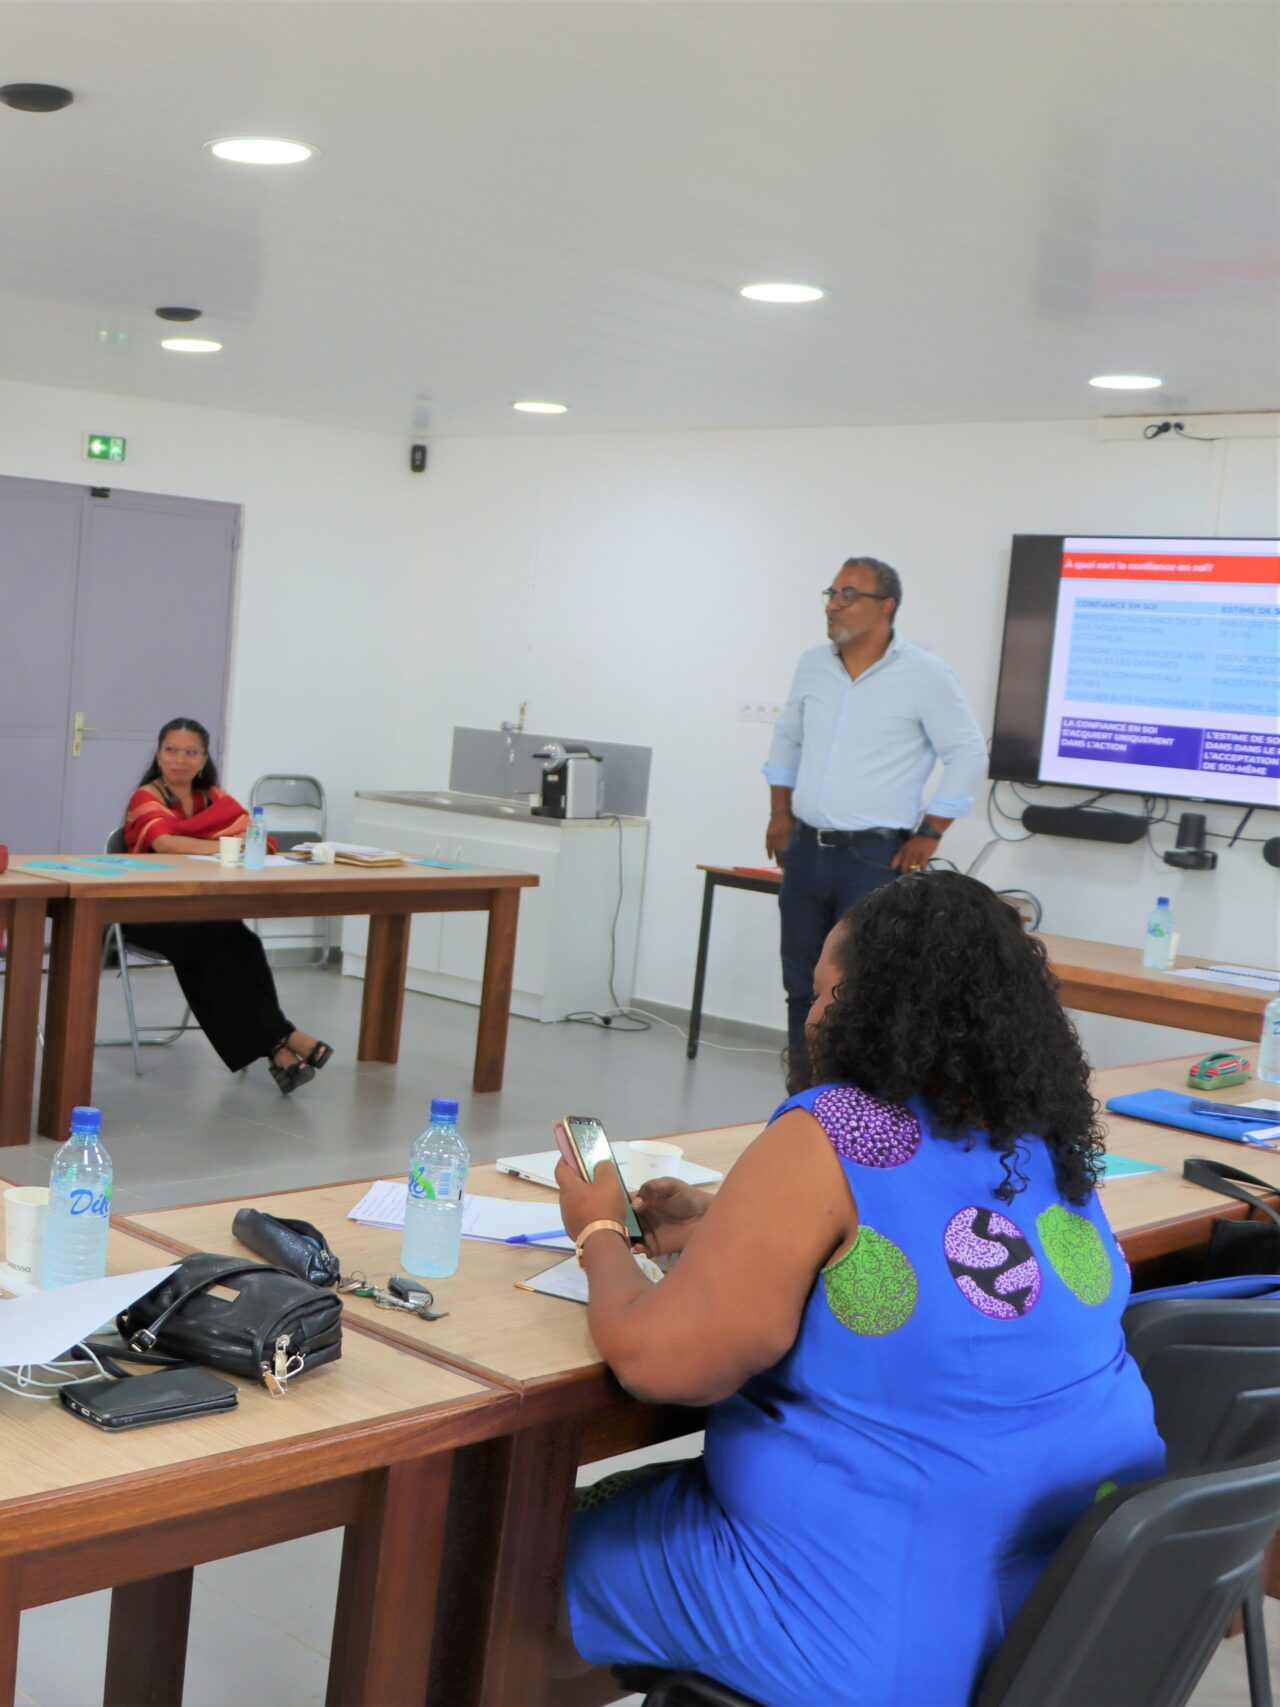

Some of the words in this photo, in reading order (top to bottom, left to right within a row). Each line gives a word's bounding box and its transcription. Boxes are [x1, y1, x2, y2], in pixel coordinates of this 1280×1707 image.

[1076, 599, 1127, 609] CONFIANCE
[1128, 600, 1142, 609] EN
[1142, 601, 1159, 610] SOI
[1222, 605, 1255, 614] ESTIME
[1258, 606, 1272, 615] DE
[1063, 719, 1075, 727] LA
[1076, 720, 1127, 731] CONFIANCE
[1128, 724, 1142, 732] EN
[1142, 725, 1159, 735] SOI
[1062, 728, 1113, 740] S'ACQUIERT
[1114, 732, 1176, 747] UNIQUEMENT
[1206, 731, 1249, 741] L'ESTIME
[1250, 735, 1265, 743] DE
[1061, 738, 1086, 748] DANS
[1087, 740, 1128, 751] L'ACTION
[1205, 741, 1233, 751] DANS
[1234, 743, 1262, 753] DANS
[1263, 746, 1277, 755] LE
[1202, 761, 1217, 770] DE
